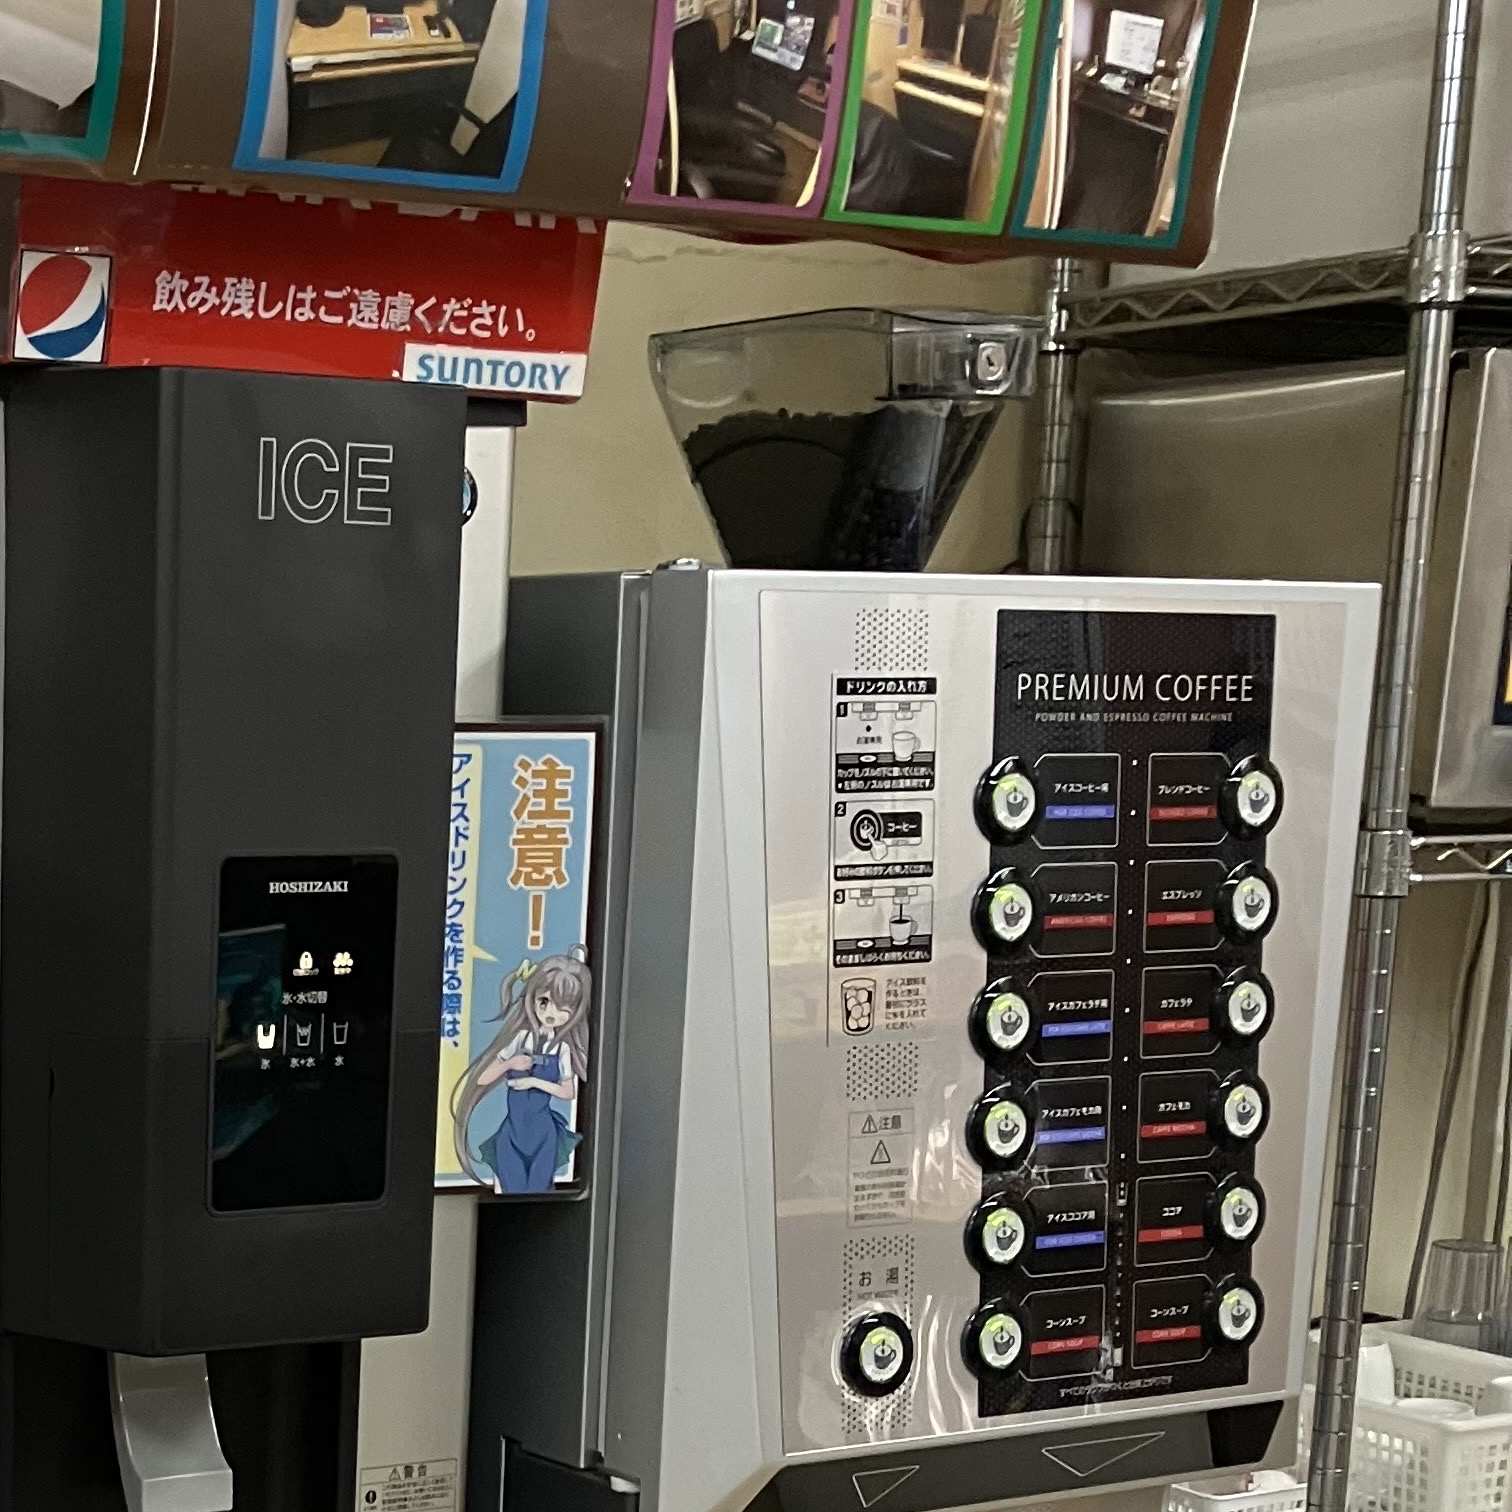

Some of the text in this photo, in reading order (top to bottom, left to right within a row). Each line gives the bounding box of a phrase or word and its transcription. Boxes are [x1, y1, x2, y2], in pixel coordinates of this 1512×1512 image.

[153, 270, 538, 342] 飲み残しはご遠慮ください。
[257, 436, 394, 527] ICE
[846, 680, 927, 693] ドリンクの入れ方
[1016, 672, 1253, 702] PREMIUM COFFEE
[1152, 712, 1187, 723] COFFEE
[837, 804, 844, 815] 2
[887, 822, 918, 832] コーヒー
[510, 755, 573, 949] 注意！
[268, 880, 349, 894] HOSHIZAKI
